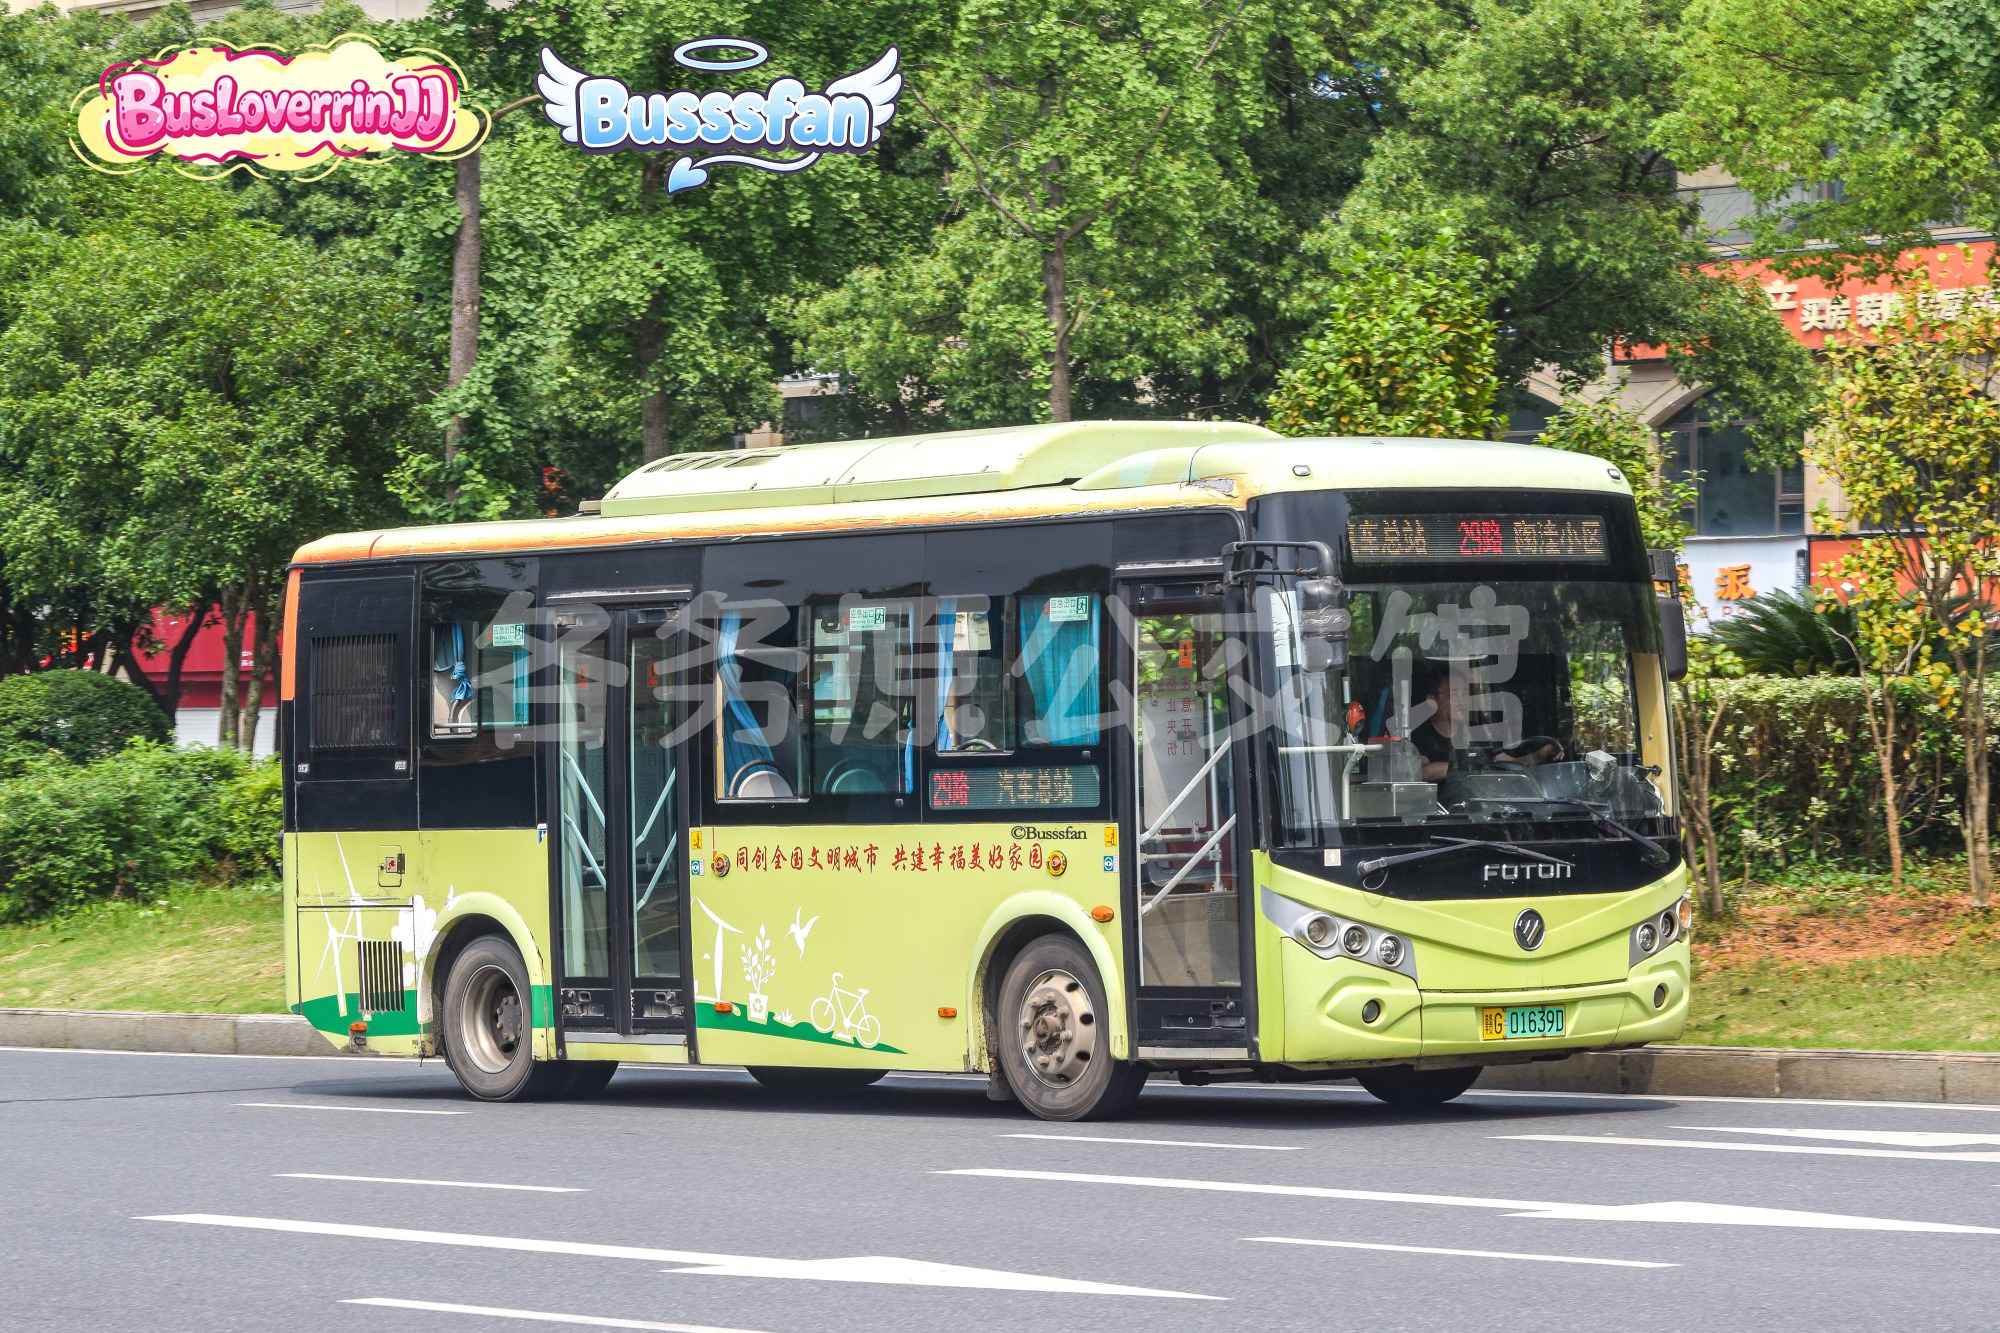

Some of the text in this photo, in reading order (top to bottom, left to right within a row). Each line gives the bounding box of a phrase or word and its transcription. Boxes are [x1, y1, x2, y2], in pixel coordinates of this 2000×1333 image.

[1458, 520, 1503, 555] 29路
[1714, 563, 1757, 600] 派
[933, 768, 1073, 805] 29路 汽车总站
[736, 842, 1043, 873] 同创全国文明城市 共建幸福美好家园
[1484, 863, 1572, 881] FOTON
